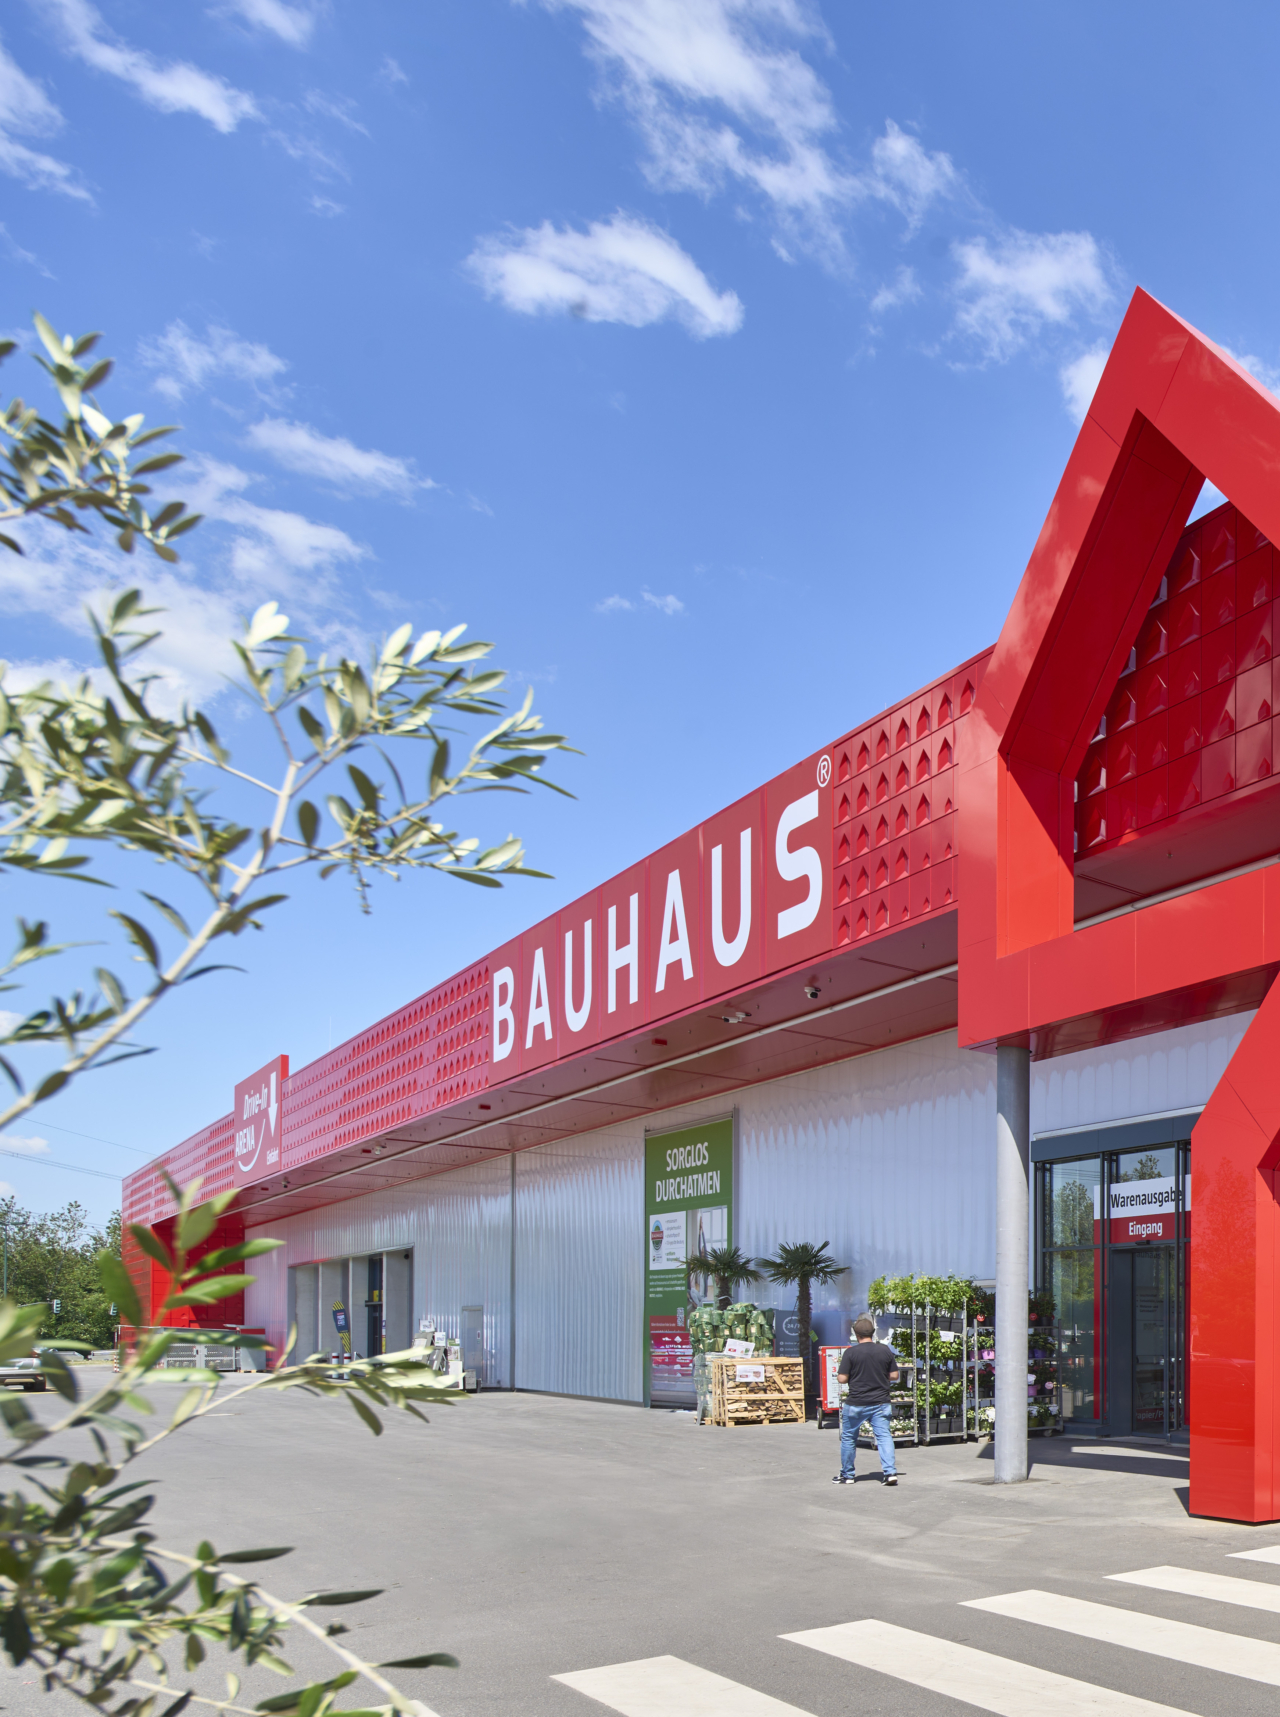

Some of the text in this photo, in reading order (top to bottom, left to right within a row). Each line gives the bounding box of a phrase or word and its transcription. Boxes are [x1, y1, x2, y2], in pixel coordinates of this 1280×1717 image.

[243, 1083, 268, 1121] Drive-In
[235, 1124, 255, 1158] ARENA
[666, 1141, 709, 1172] SORGLOS
[655, 1170, 721, 1202] DURCHATMEN
[1128, 1221, 1163, 1238] Eingang
